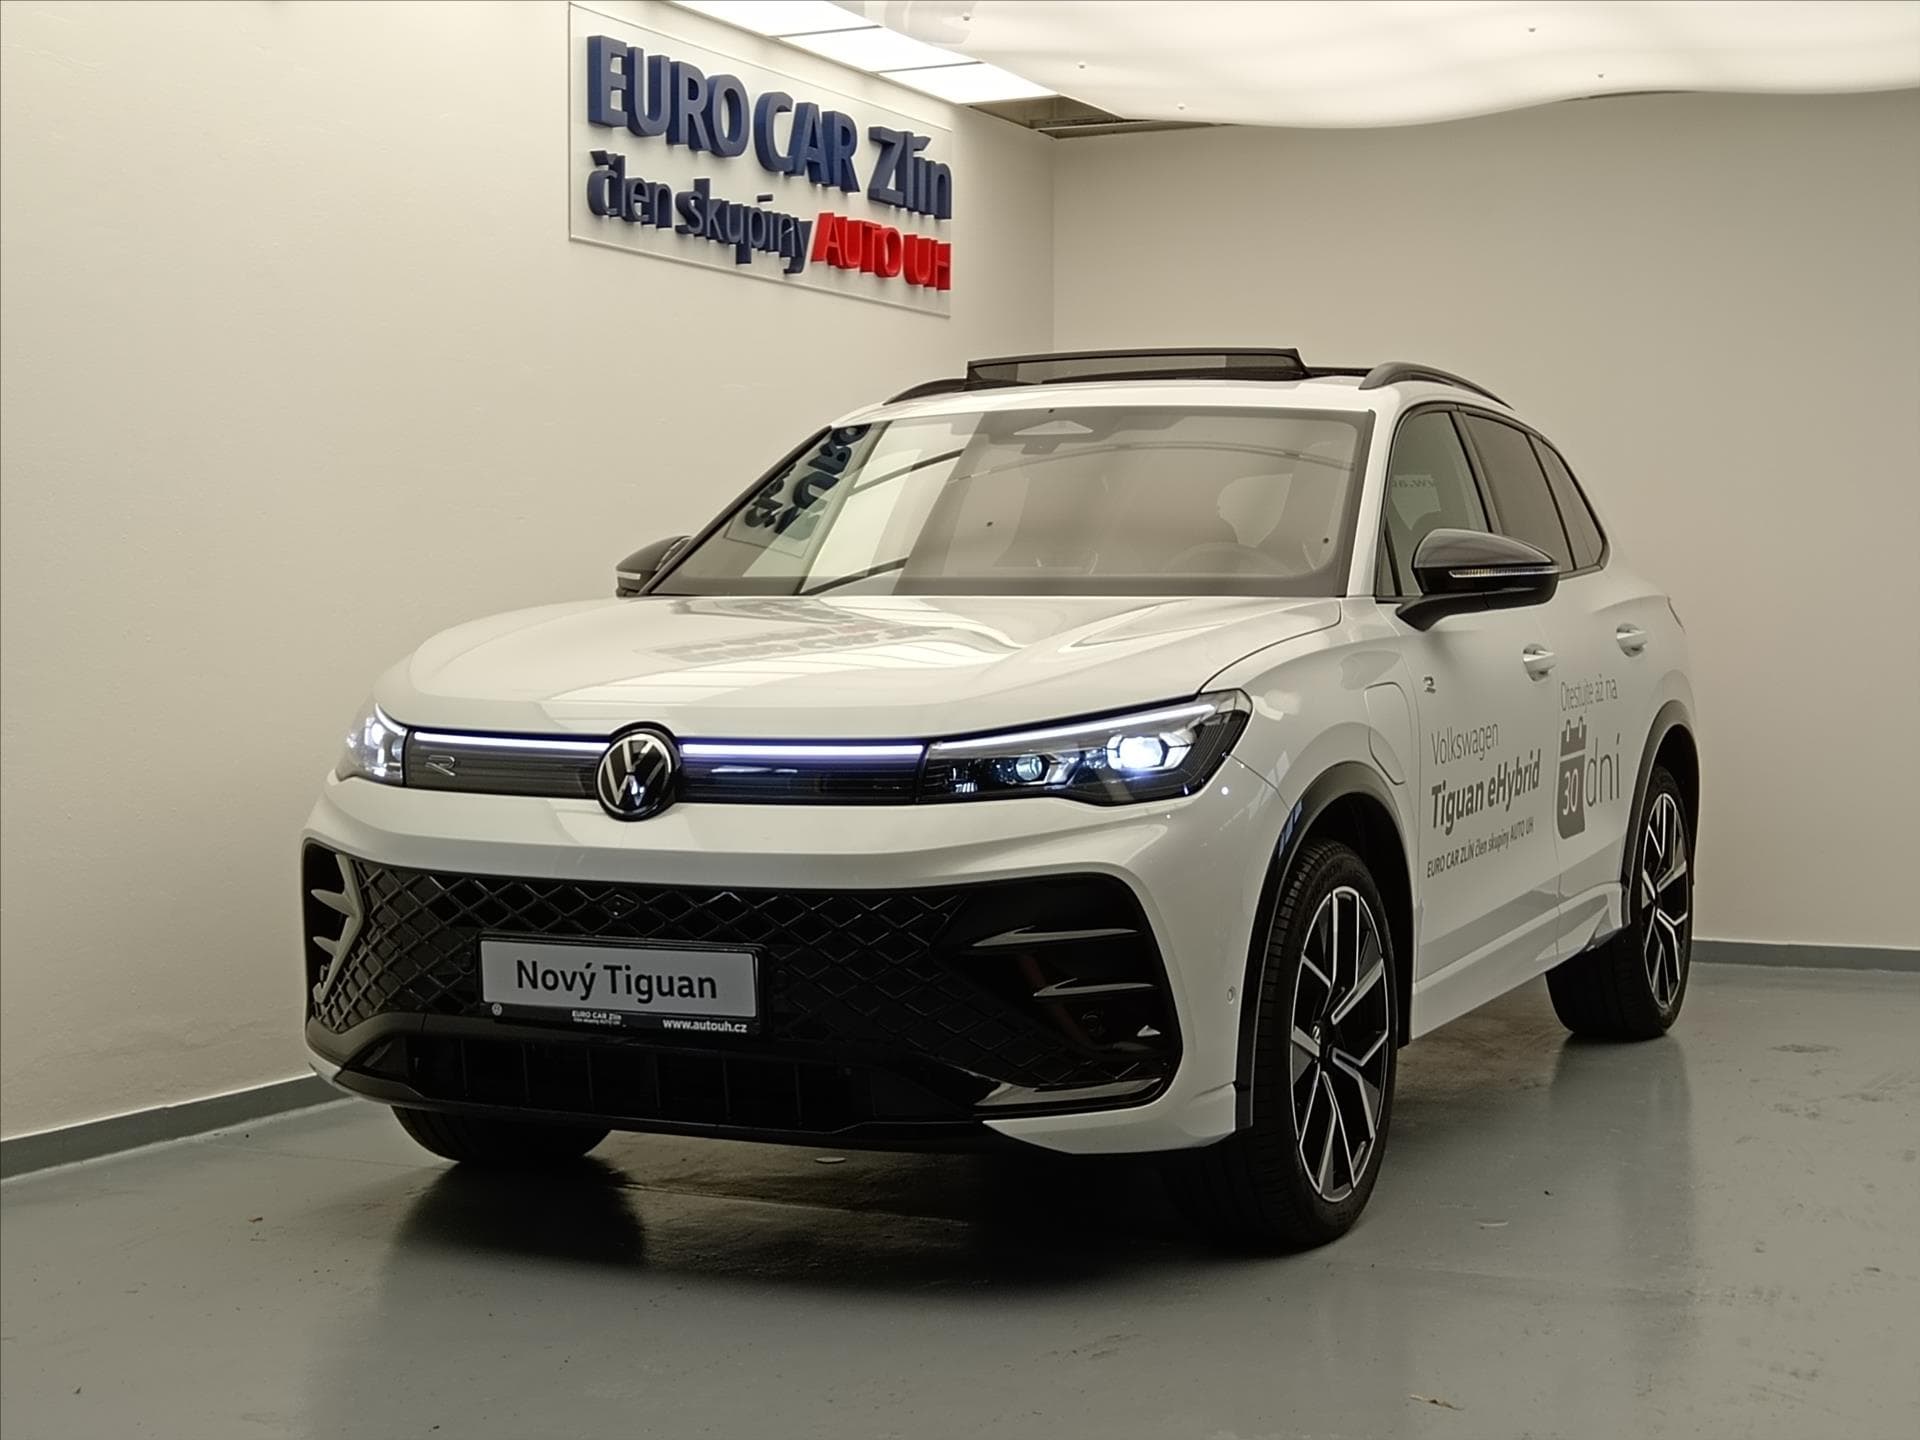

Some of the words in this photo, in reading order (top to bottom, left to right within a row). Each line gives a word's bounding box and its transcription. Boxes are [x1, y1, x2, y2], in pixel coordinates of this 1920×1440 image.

[587, 35, 750, 158] EURO
[754, 91, 860, 193] CAR
[867, 126, 952, 220] Zlín
[587, 150, 673, 229] člen
[675, 178, 814, 274] skupiny
[811, 212, 902, 278] AUTO
[903, 234, 952, 290] UH
[1605, 678, 1618, 701] na
[1431, 723, 1499, 766] Volkswagen
[1431, 779, 1485, 836] Tiguan
[1487, 748, 1542, 813] eHybrid
[1562, 768, 1580, 816] 30
[1427, 855, 1446, 878] EURO
[1446, 848, 1460, 870] CAR
[516, 960, 597, 1001] Nový
[603, 964, 718, 1004] Tiguan
[572, 1010, 591, 1018] EURO
[592, 1011, 607, 1019] CAR
[662, 1018, 748, 1033] www.autouh.cz
